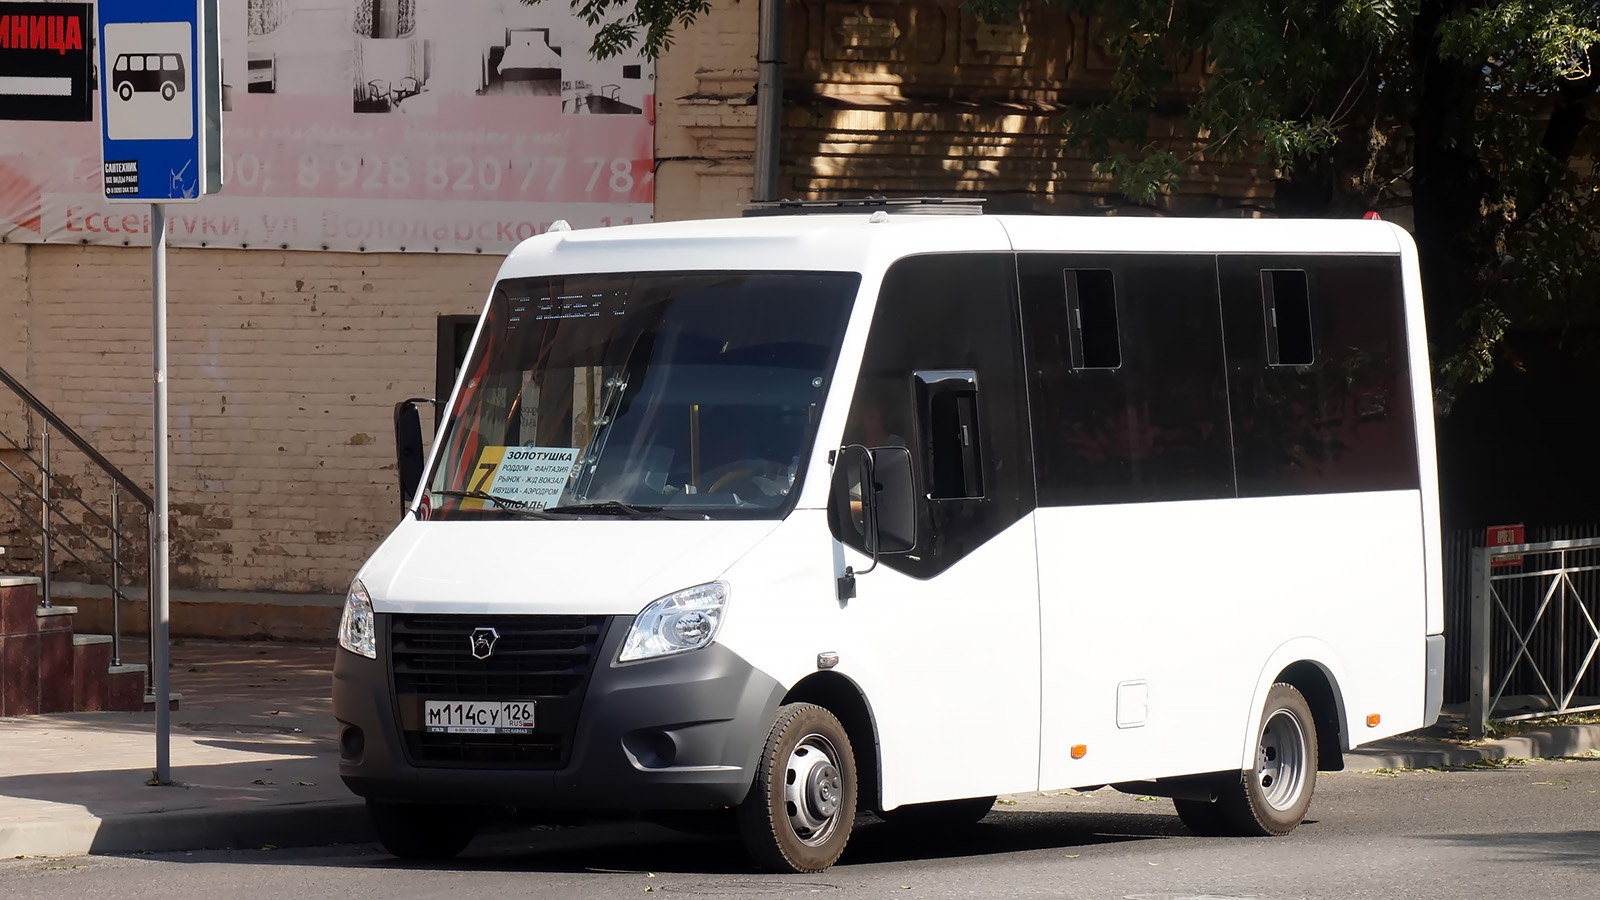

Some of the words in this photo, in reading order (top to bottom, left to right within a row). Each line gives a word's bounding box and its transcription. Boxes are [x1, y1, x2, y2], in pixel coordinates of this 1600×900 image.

[105, 162, 138, 173] САНТЕХНИК
[126, 175, 138, 183] РАБОТ
[297, 155, 320, 188] 8
[335, 155, 410, 190] 928
[425, 155, 501, 192] 820
[519, 156, 567, 193] 77
[583, 156, 634, 194] 78
[507, 451, 572, 461] ЗОЛОТУШКА
[502, 464, 529, 472] РОДДОМ
[472, 463, 498, 494] 7
[498, 475, 521, 483] РЫНОК
[493, 486, 518, 494] ИВУШКА
[523, 487, 559, 495] АЭРОДРОМ
[429, 704, 499, 725] М114СУ
[504, 704, 530, 720] 126
